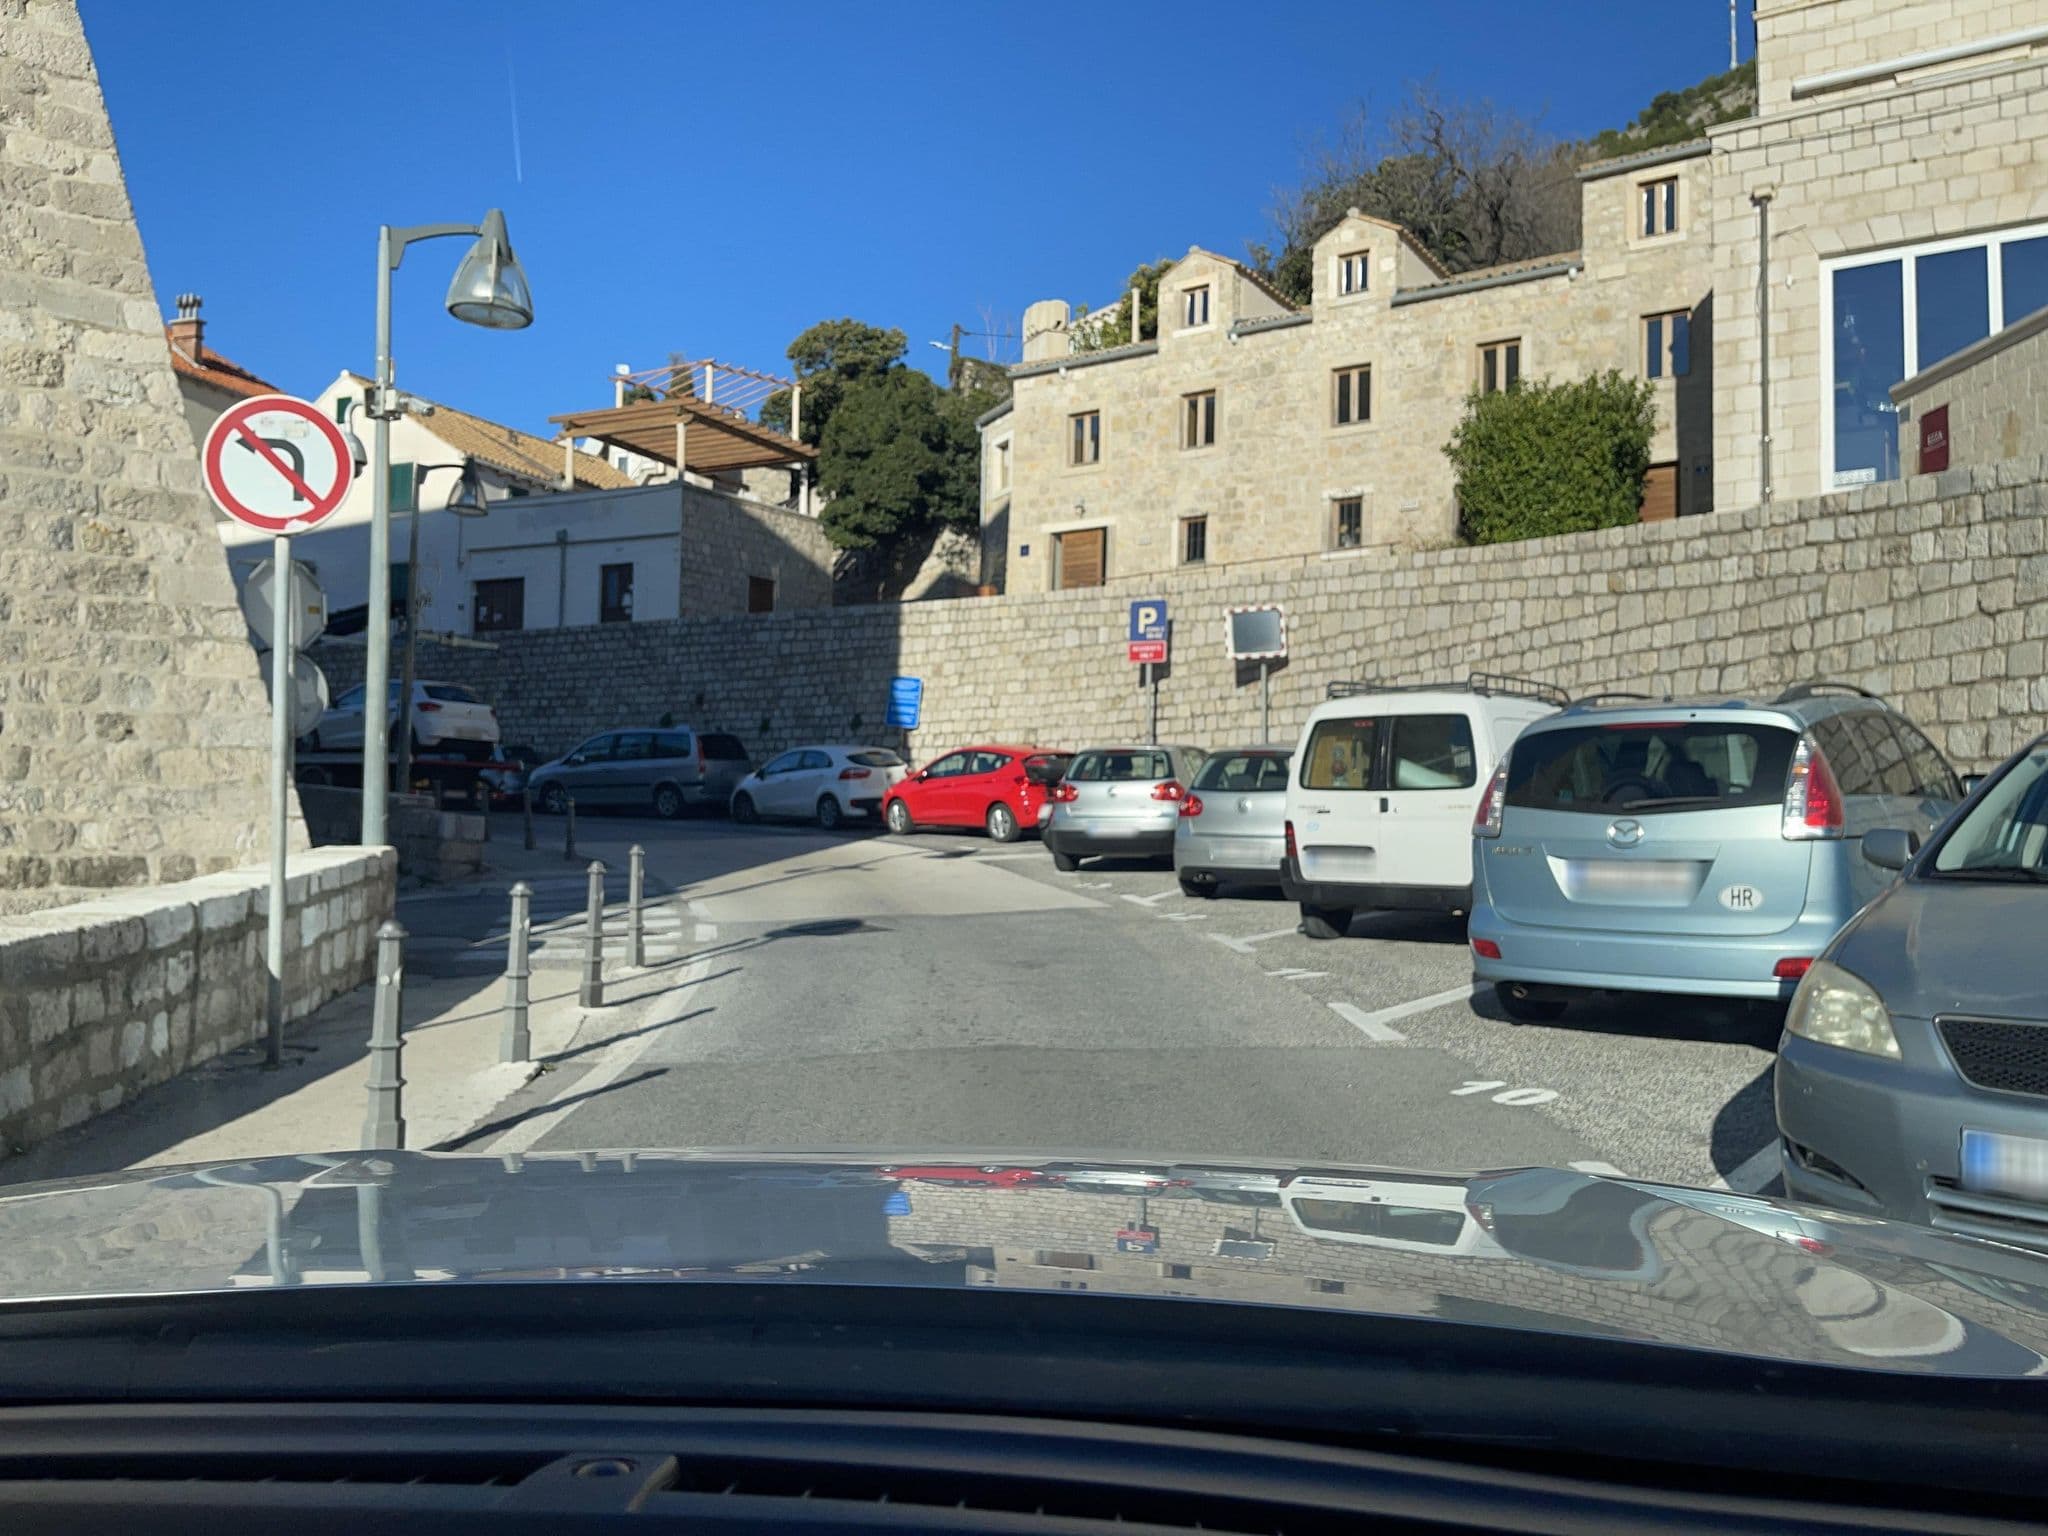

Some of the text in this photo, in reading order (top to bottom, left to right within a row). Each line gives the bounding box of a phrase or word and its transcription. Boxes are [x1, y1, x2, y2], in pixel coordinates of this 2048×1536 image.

[1138, 607, 1157, 634] P
[1731, 888, 1752, 906] HR
[1449, 1081, 1559, 1106] 10
